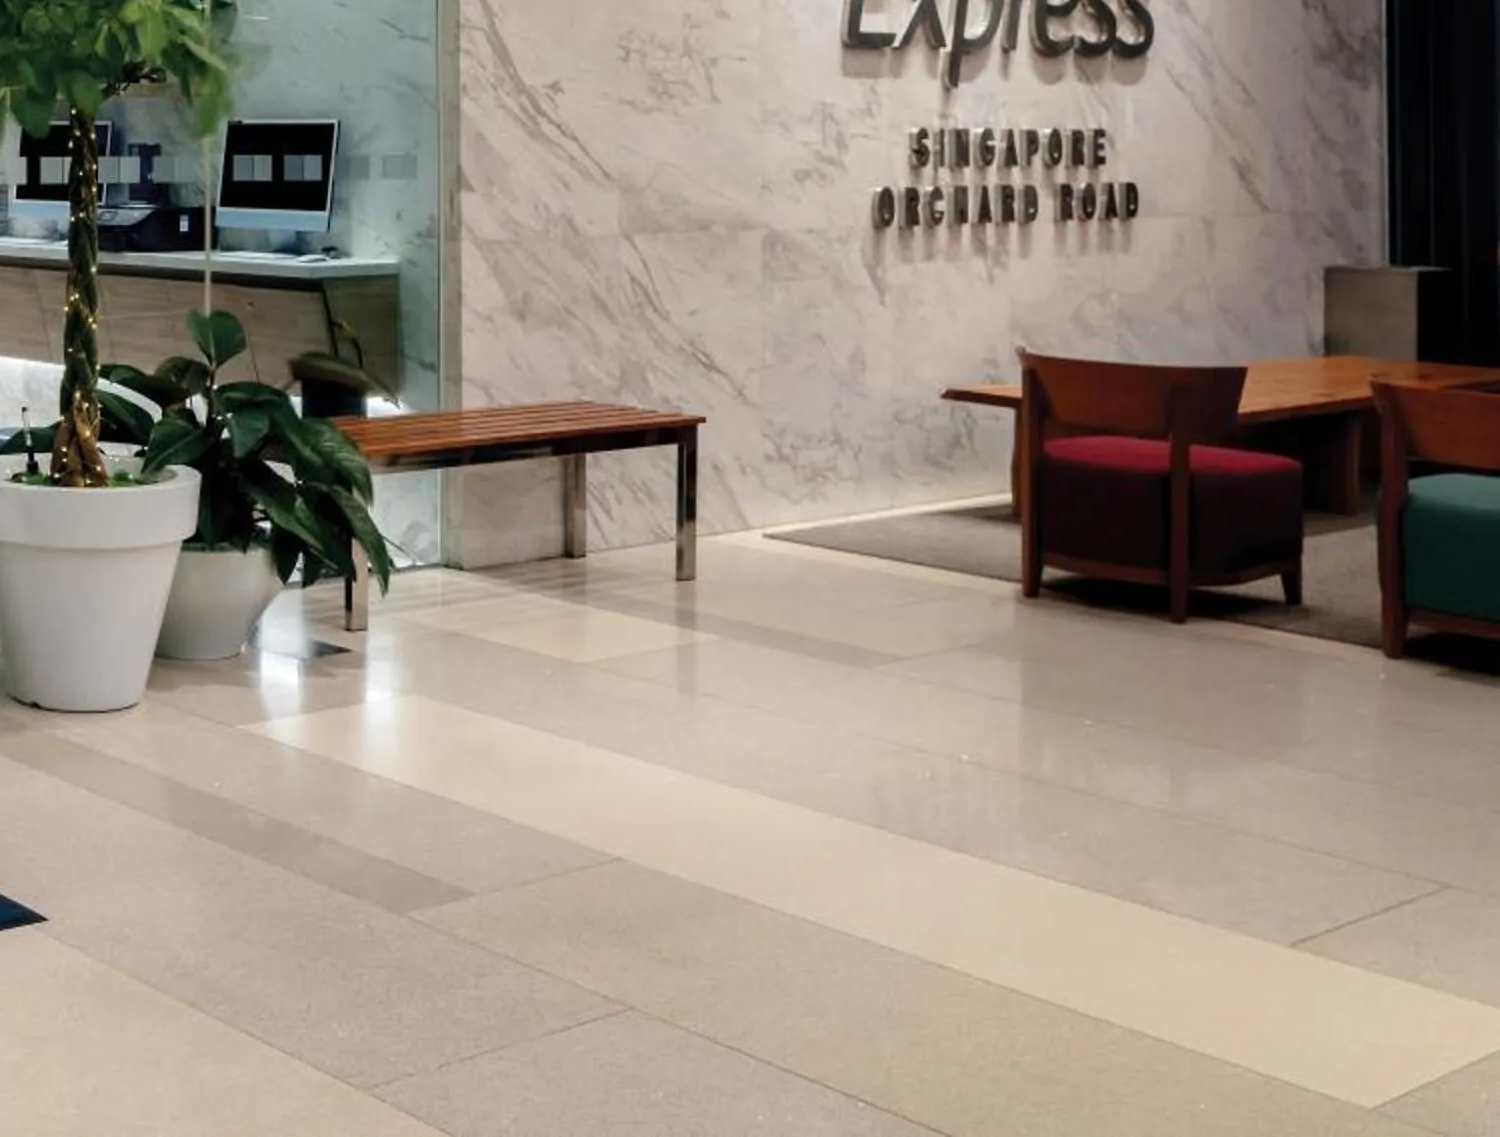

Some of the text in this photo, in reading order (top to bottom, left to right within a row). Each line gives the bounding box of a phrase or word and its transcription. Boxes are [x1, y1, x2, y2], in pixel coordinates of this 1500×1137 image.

[908, 127, 1107, 169] SINGAPORE
[871, 181, 1139, 230] ORCHARD ROAD
